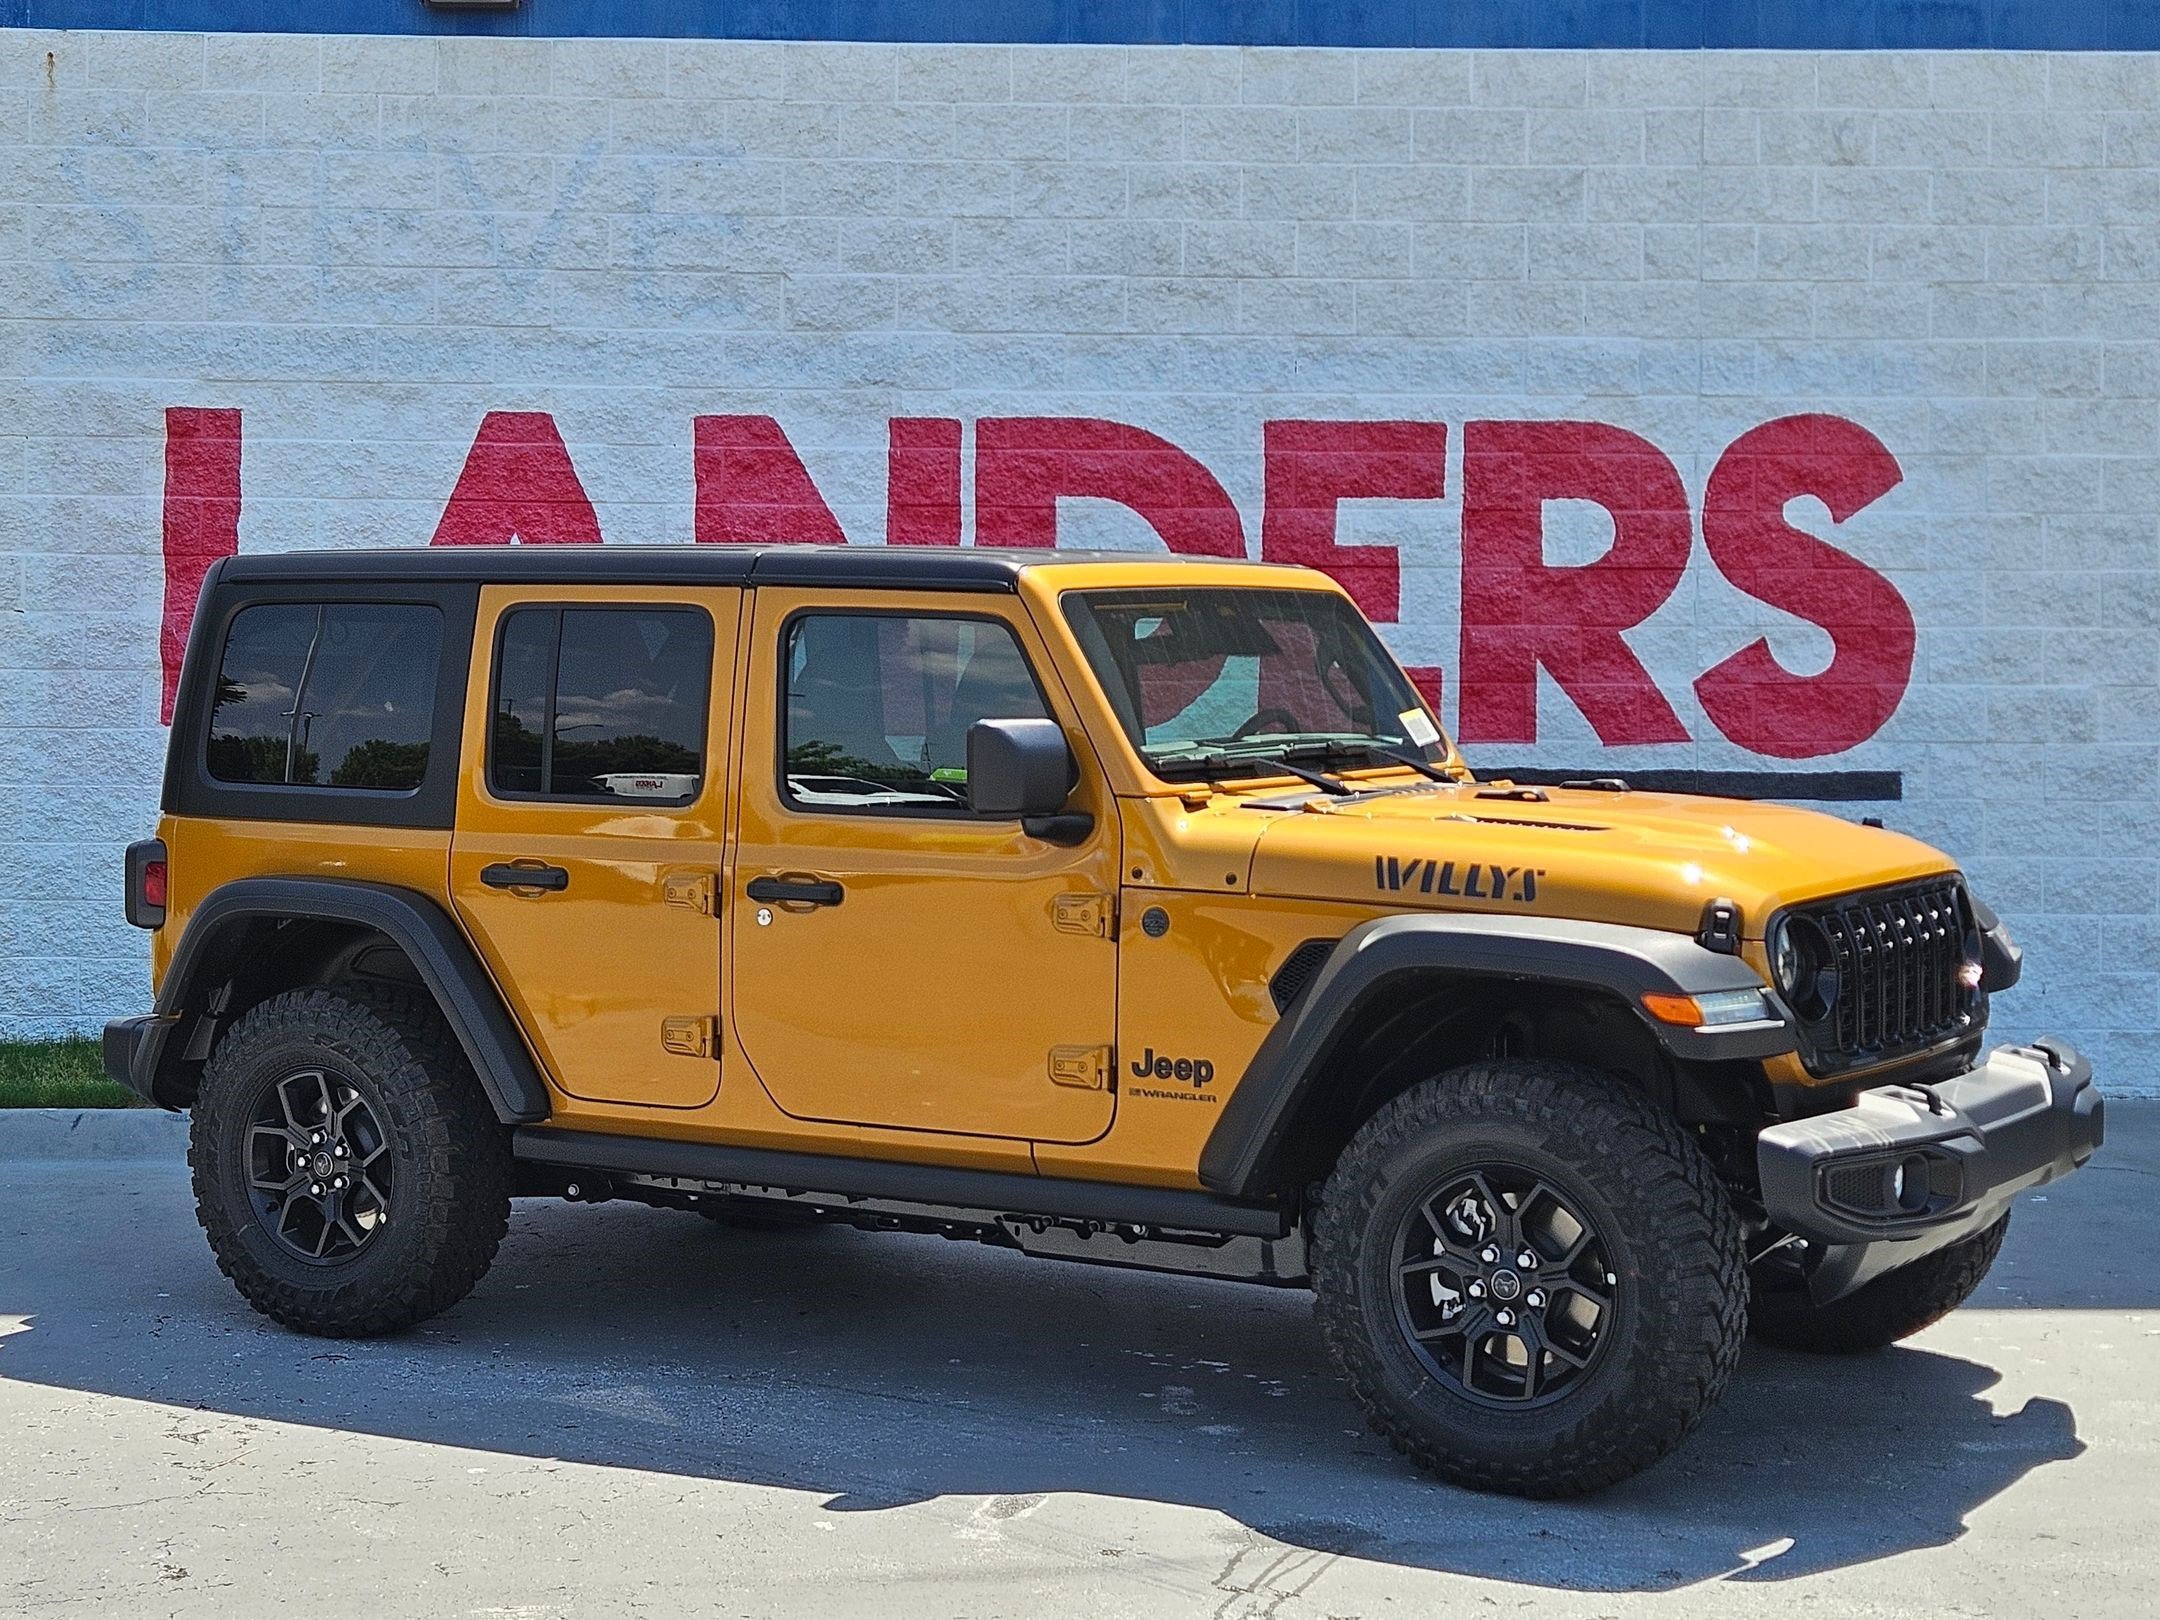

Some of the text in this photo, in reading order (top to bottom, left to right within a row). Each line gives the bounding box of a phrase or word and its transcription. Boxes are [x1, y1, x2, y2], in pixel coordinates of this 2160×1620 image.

[1376, 855, 1546, 902] WILLYS
[1131, 1047, 1214, 1088] Jeep
[1142, 1088, 1217, 1103] WRANGLER
